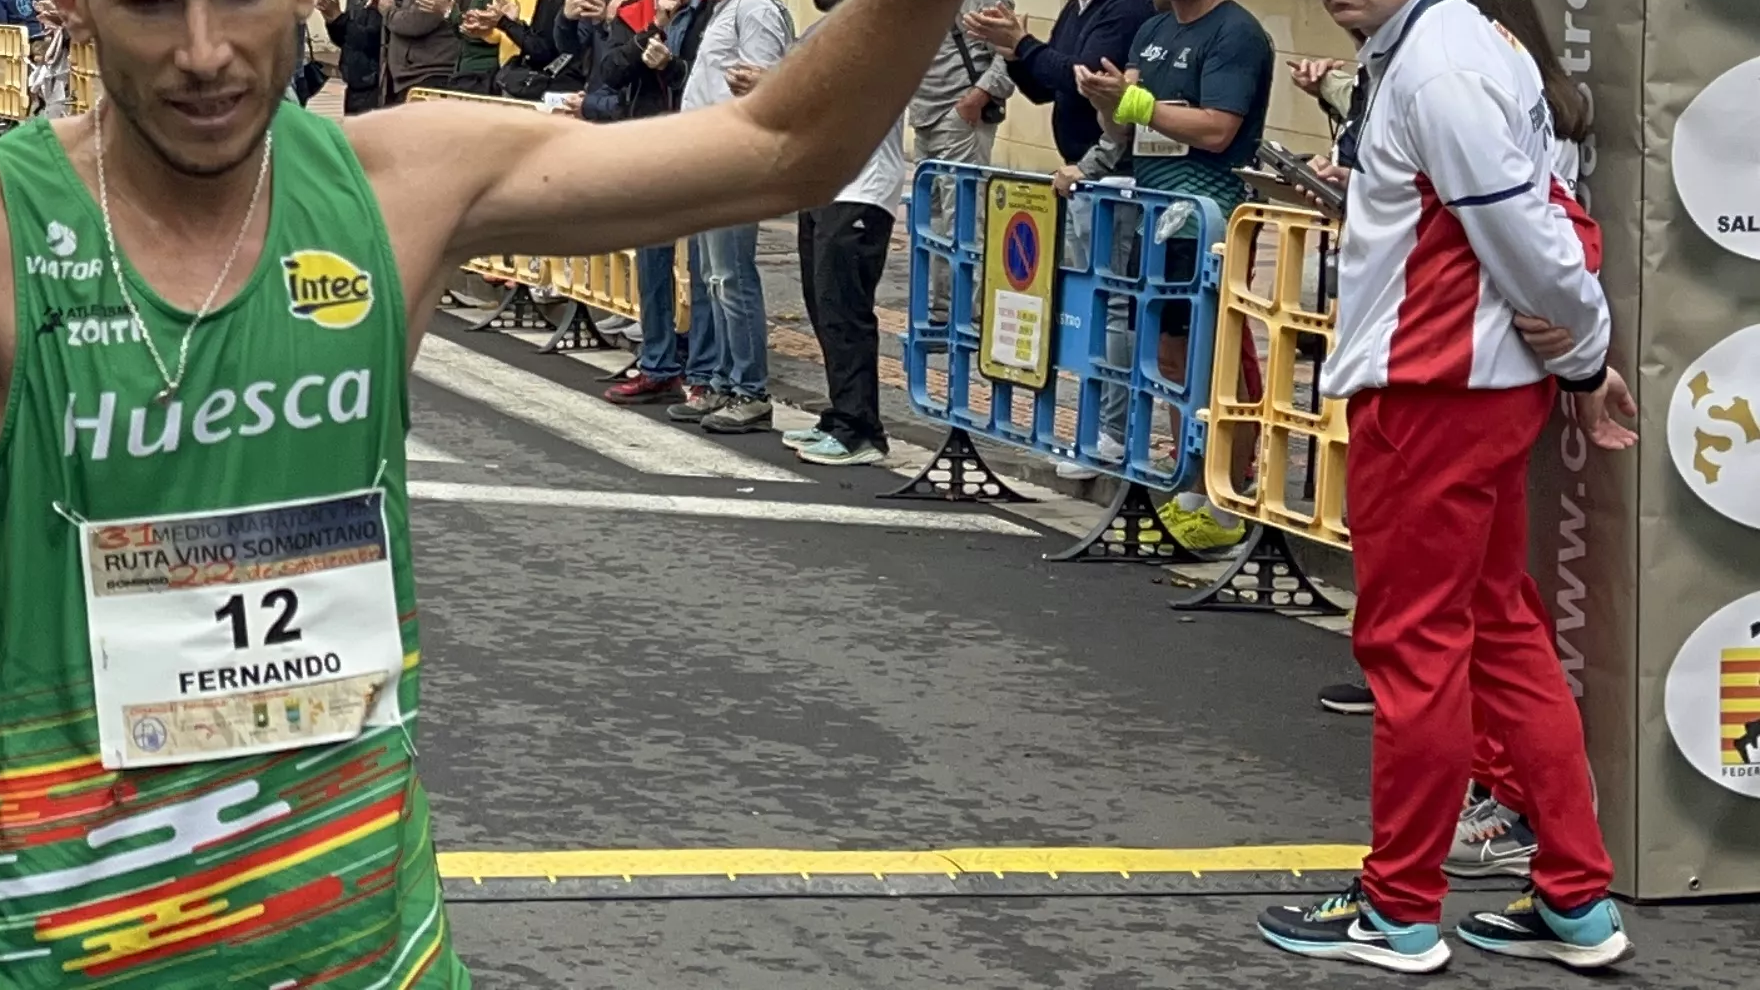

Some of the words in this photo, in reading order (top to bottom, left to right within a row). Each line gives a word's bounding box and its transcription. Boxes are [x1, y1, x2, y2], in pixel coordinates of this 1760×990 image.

[1717, 215, 1760, 233] SAL
[25, 255, 104, 280] VIATOR
[64, 368, 372, 461] Huesca
[97, 522, 162, 550] 31
[151, 522, 223, 543] MEDIO
[103, 550, 171, 573] RUTA
[174, 542, 237, 567] VINO
[242, 520, 379, 560] SOMONTANO
[214, 587, 302, 650] 12
[177, 652, 342, 694] FERNANDO
